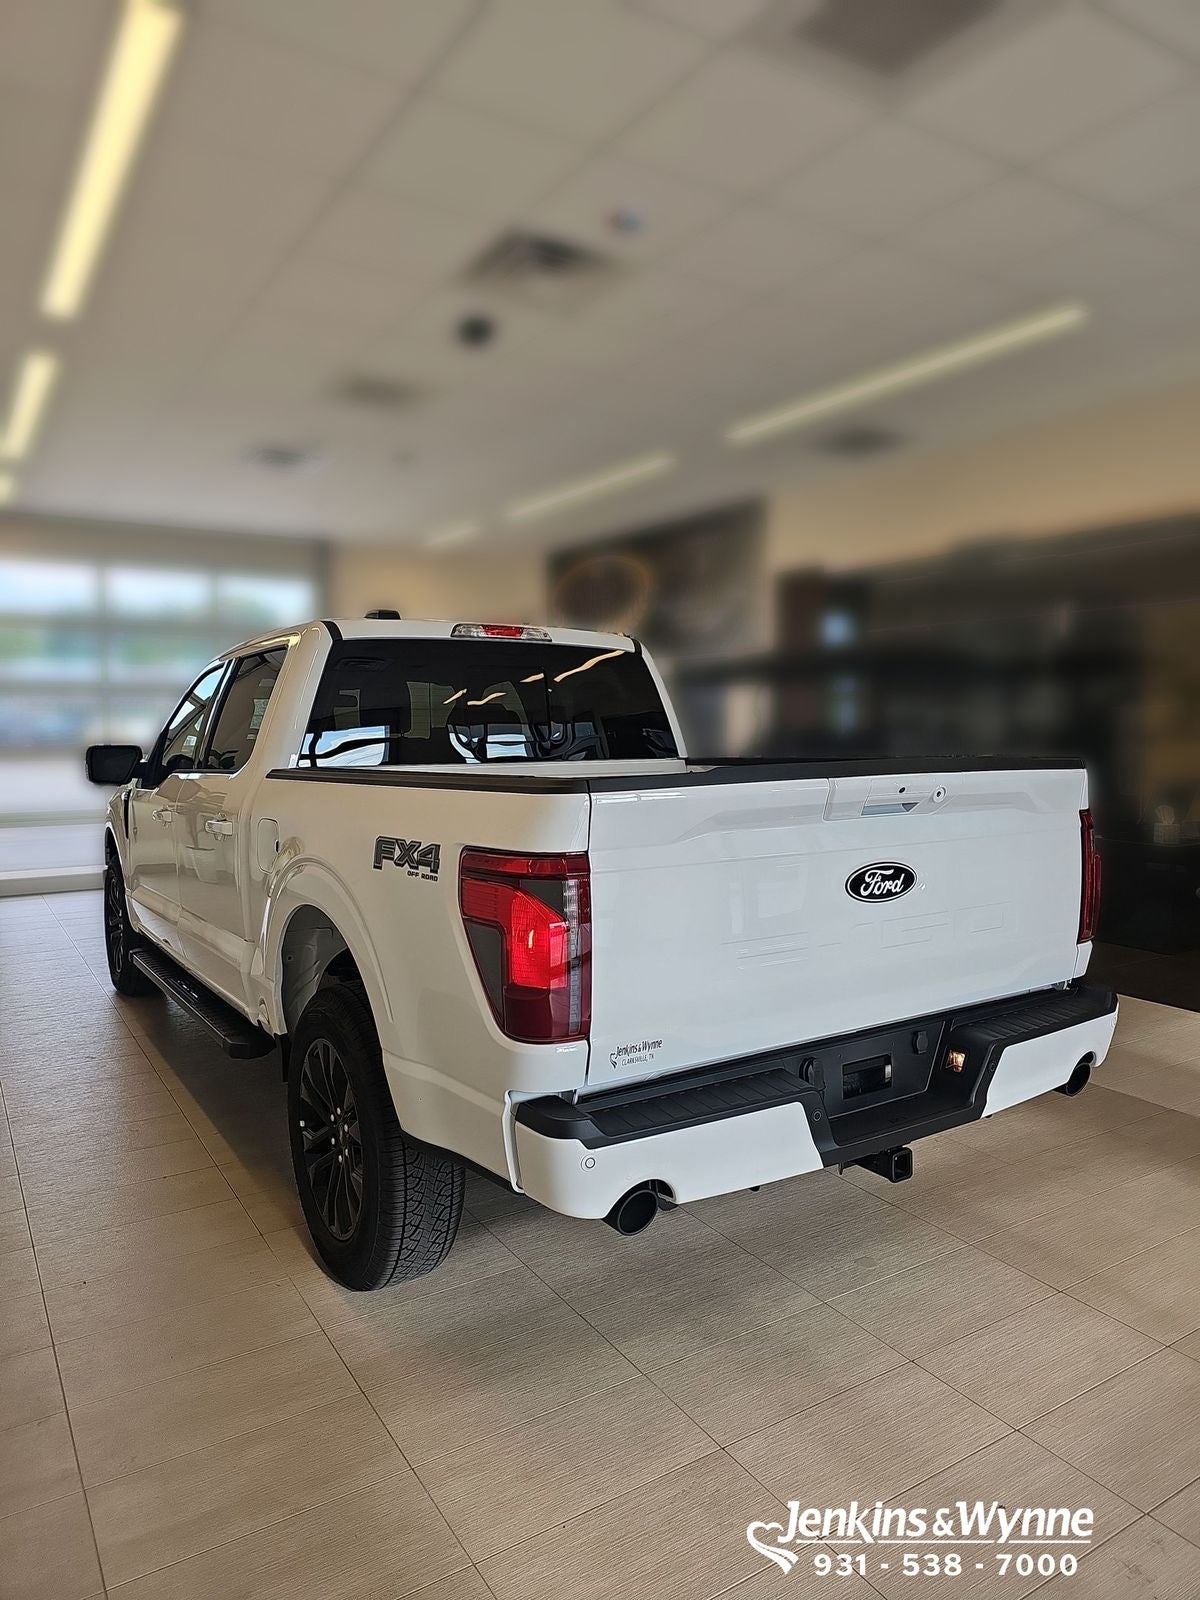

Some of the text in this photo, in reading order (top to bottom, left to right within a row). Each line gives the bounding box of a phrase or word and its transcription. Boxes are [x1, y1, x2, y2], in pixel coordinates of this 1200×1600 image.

[373, 835, 441, 874] FX4
[421, 873, 438, 881] ROAD
[860, 868, 905, 896] Ford
